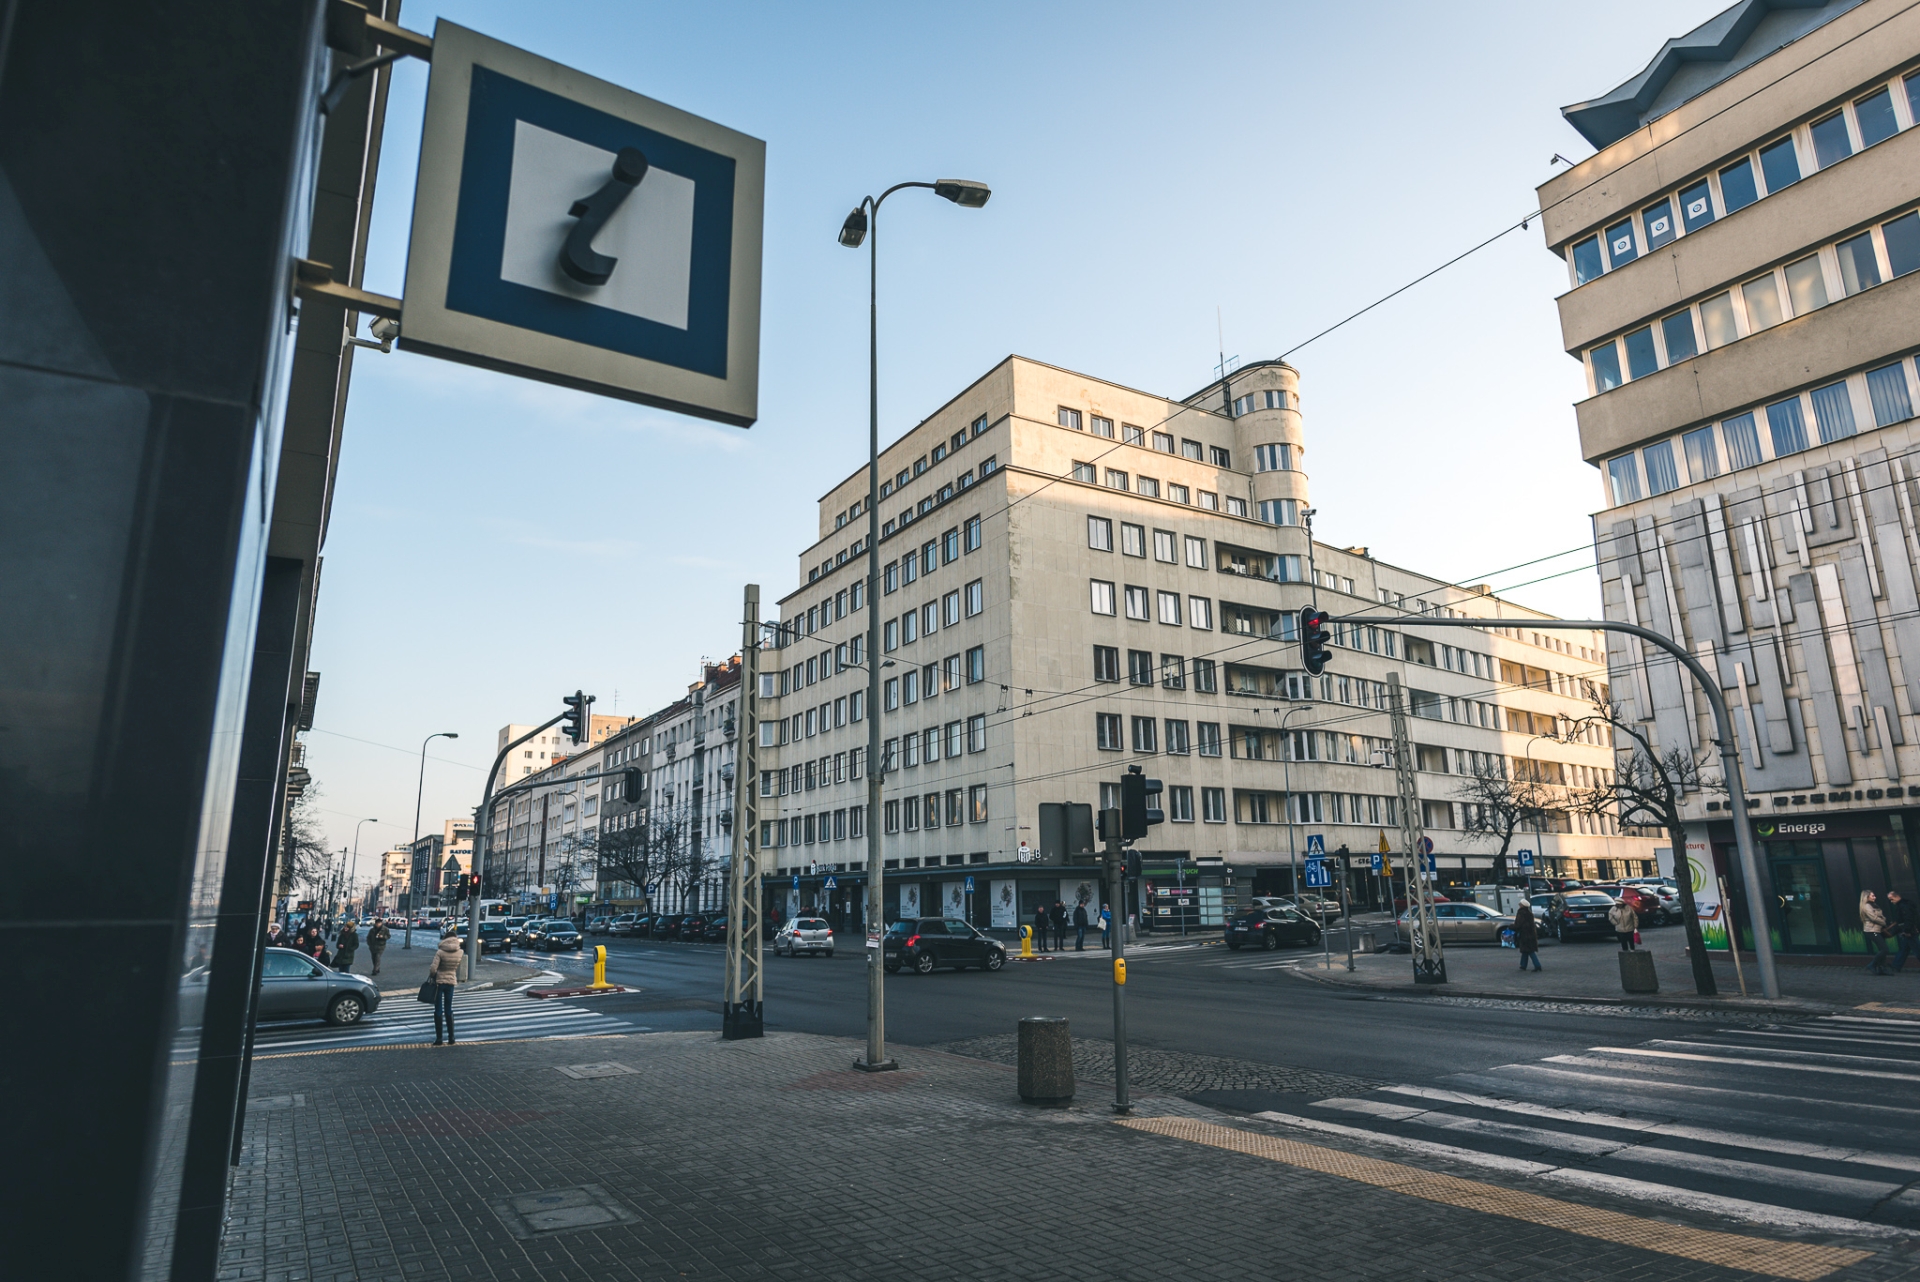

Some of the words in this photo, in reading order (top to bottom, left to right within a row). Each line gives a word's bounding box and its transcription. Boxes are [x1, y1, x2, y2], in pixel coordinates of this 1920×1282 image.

[1778, 822, 1826, 834] Energa
[1373, 855, 1380, 865] P
[1521, 852, 1530, 864] P
